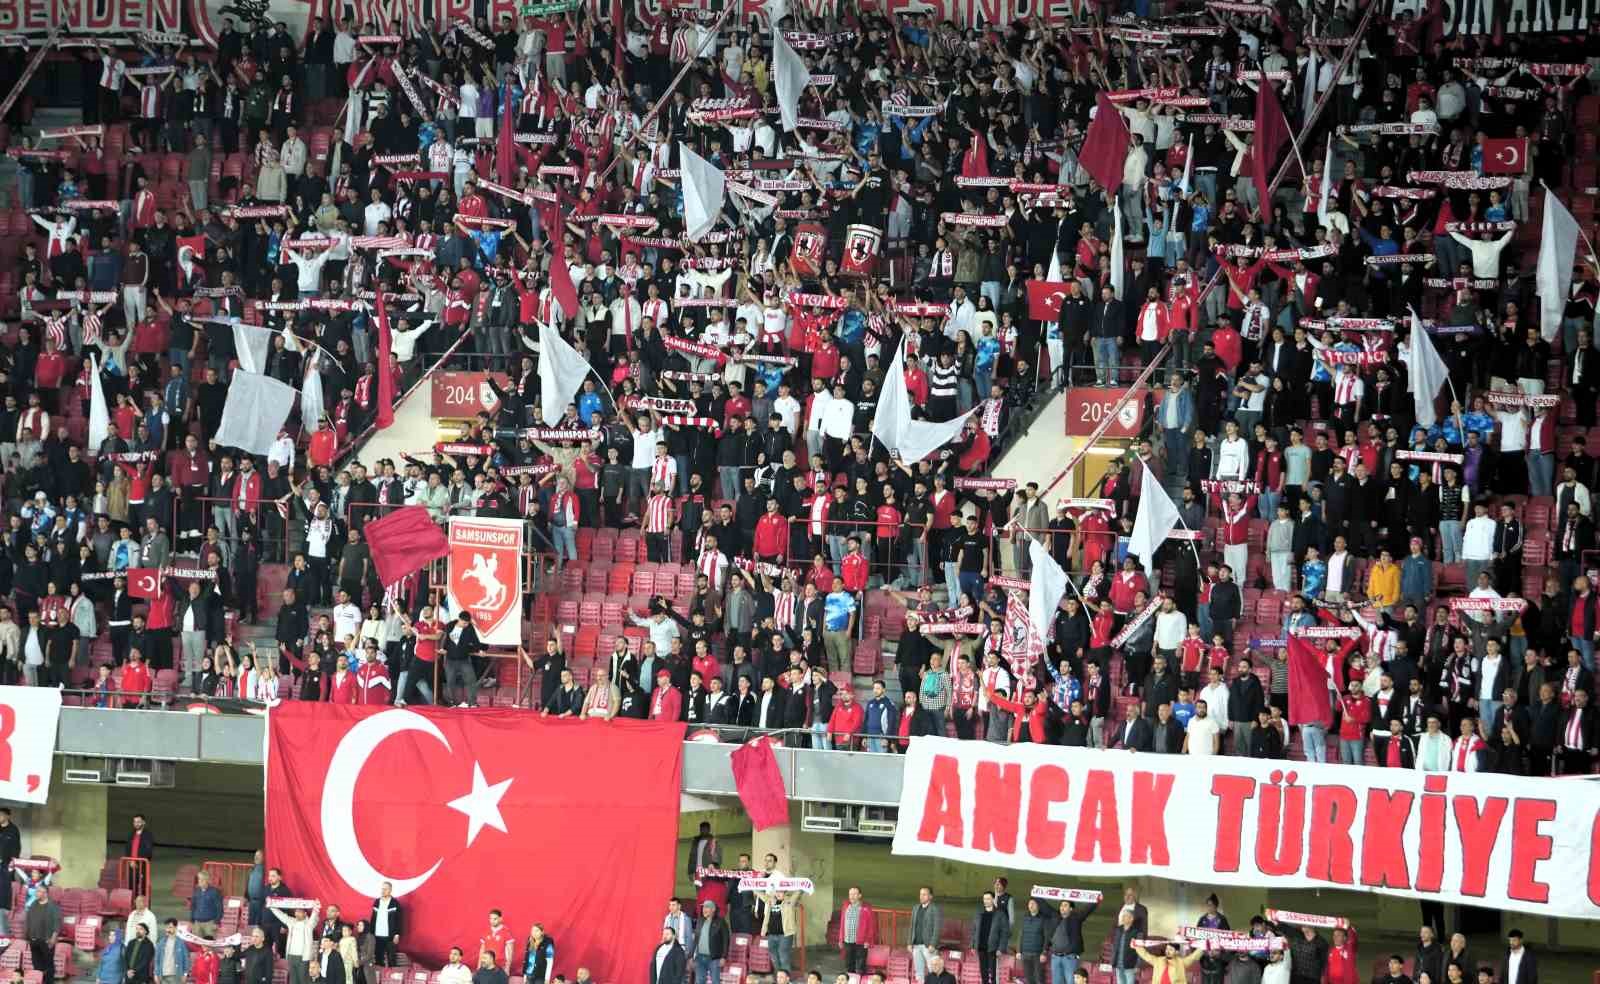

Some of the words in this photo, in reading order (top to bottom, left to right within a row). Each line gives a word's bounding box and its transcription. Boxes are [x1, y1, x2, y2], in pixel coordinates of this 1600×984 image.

[446, 385, 475, 405] 204
[1081, 402, 1113, 422] 205
[541, 429, 588, 441] SAMSUNSPOR
[964, 480, 1006, 490] SAMSUNSPOR
[455, 528, 516, 545] SAMSUNSPOR
[916, 754, 1176, 866] ANCAK
[1211, 769, 1557, 903] TÜRKİYE
